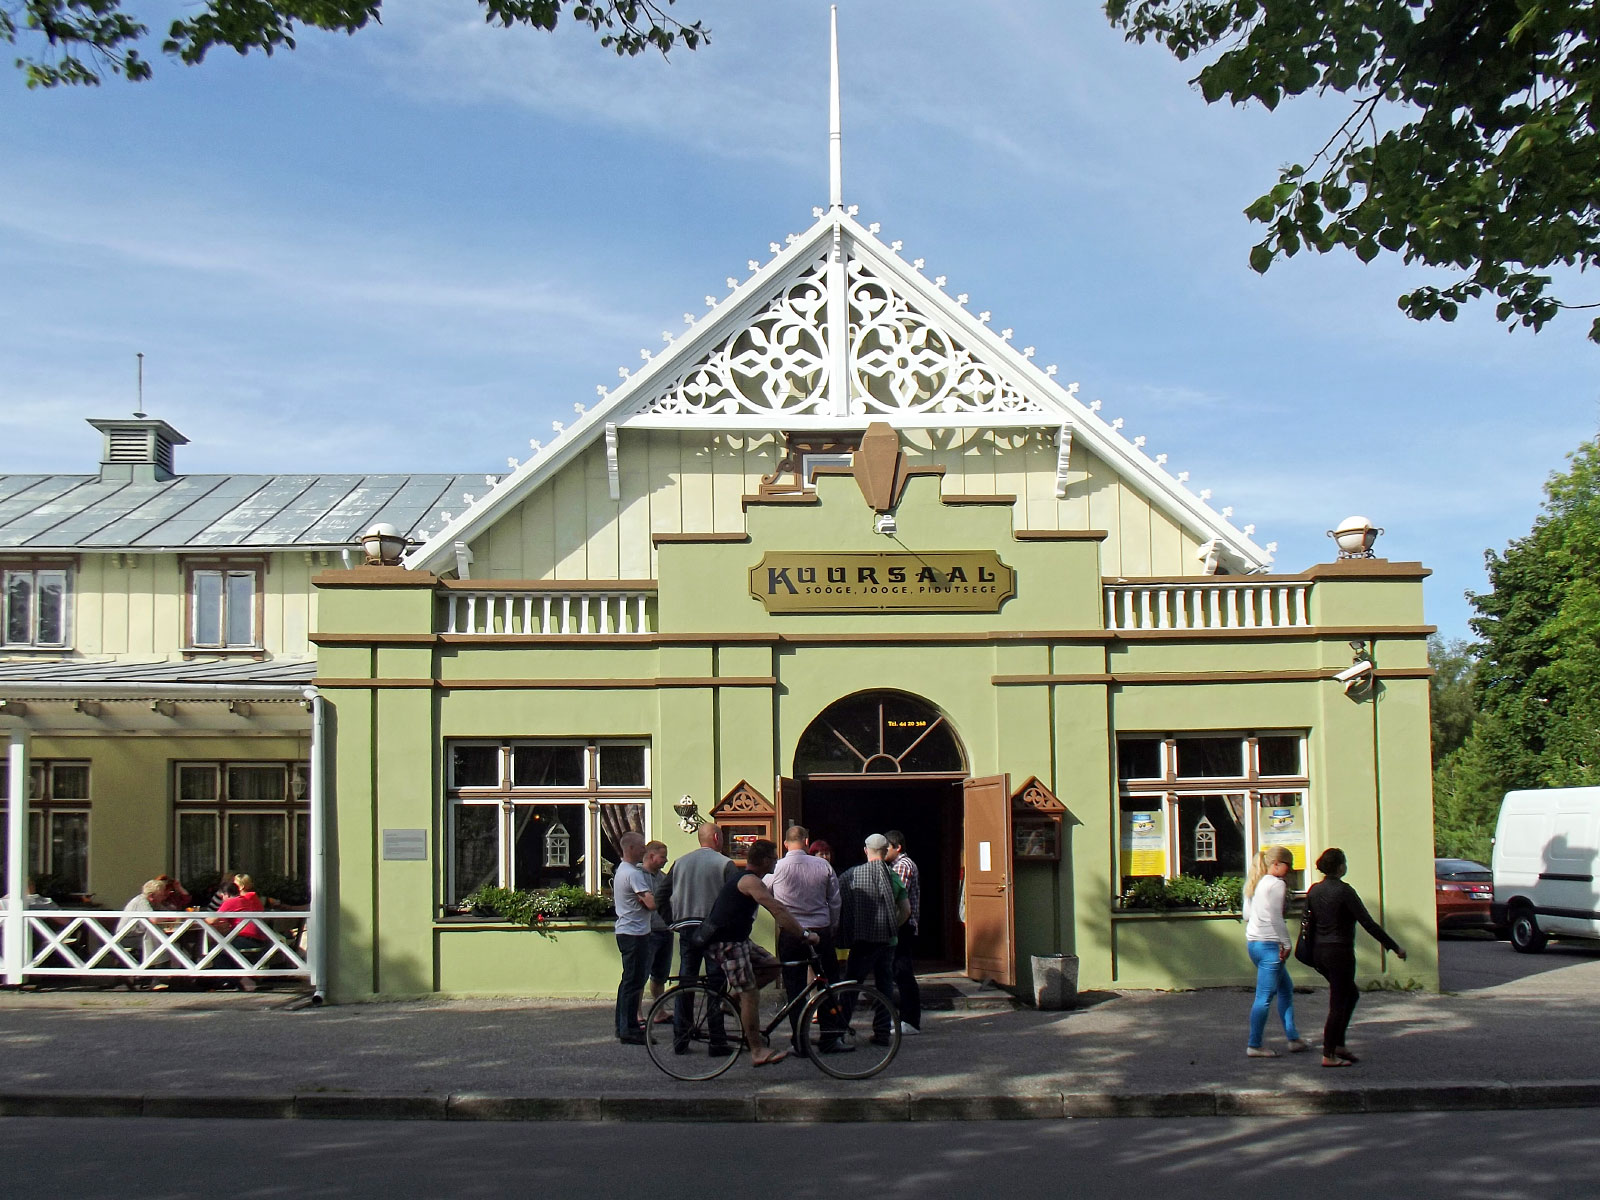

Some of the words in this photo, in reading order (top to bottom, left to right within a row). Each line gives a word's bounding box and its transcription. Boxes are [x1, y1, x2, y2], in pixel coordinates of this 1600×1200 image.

[767, 567, 996, 594] KUURSAAL
[863, 586, 913, 595] JOOGE,
[919, 586, 996, 594] PIDUTSEGE
